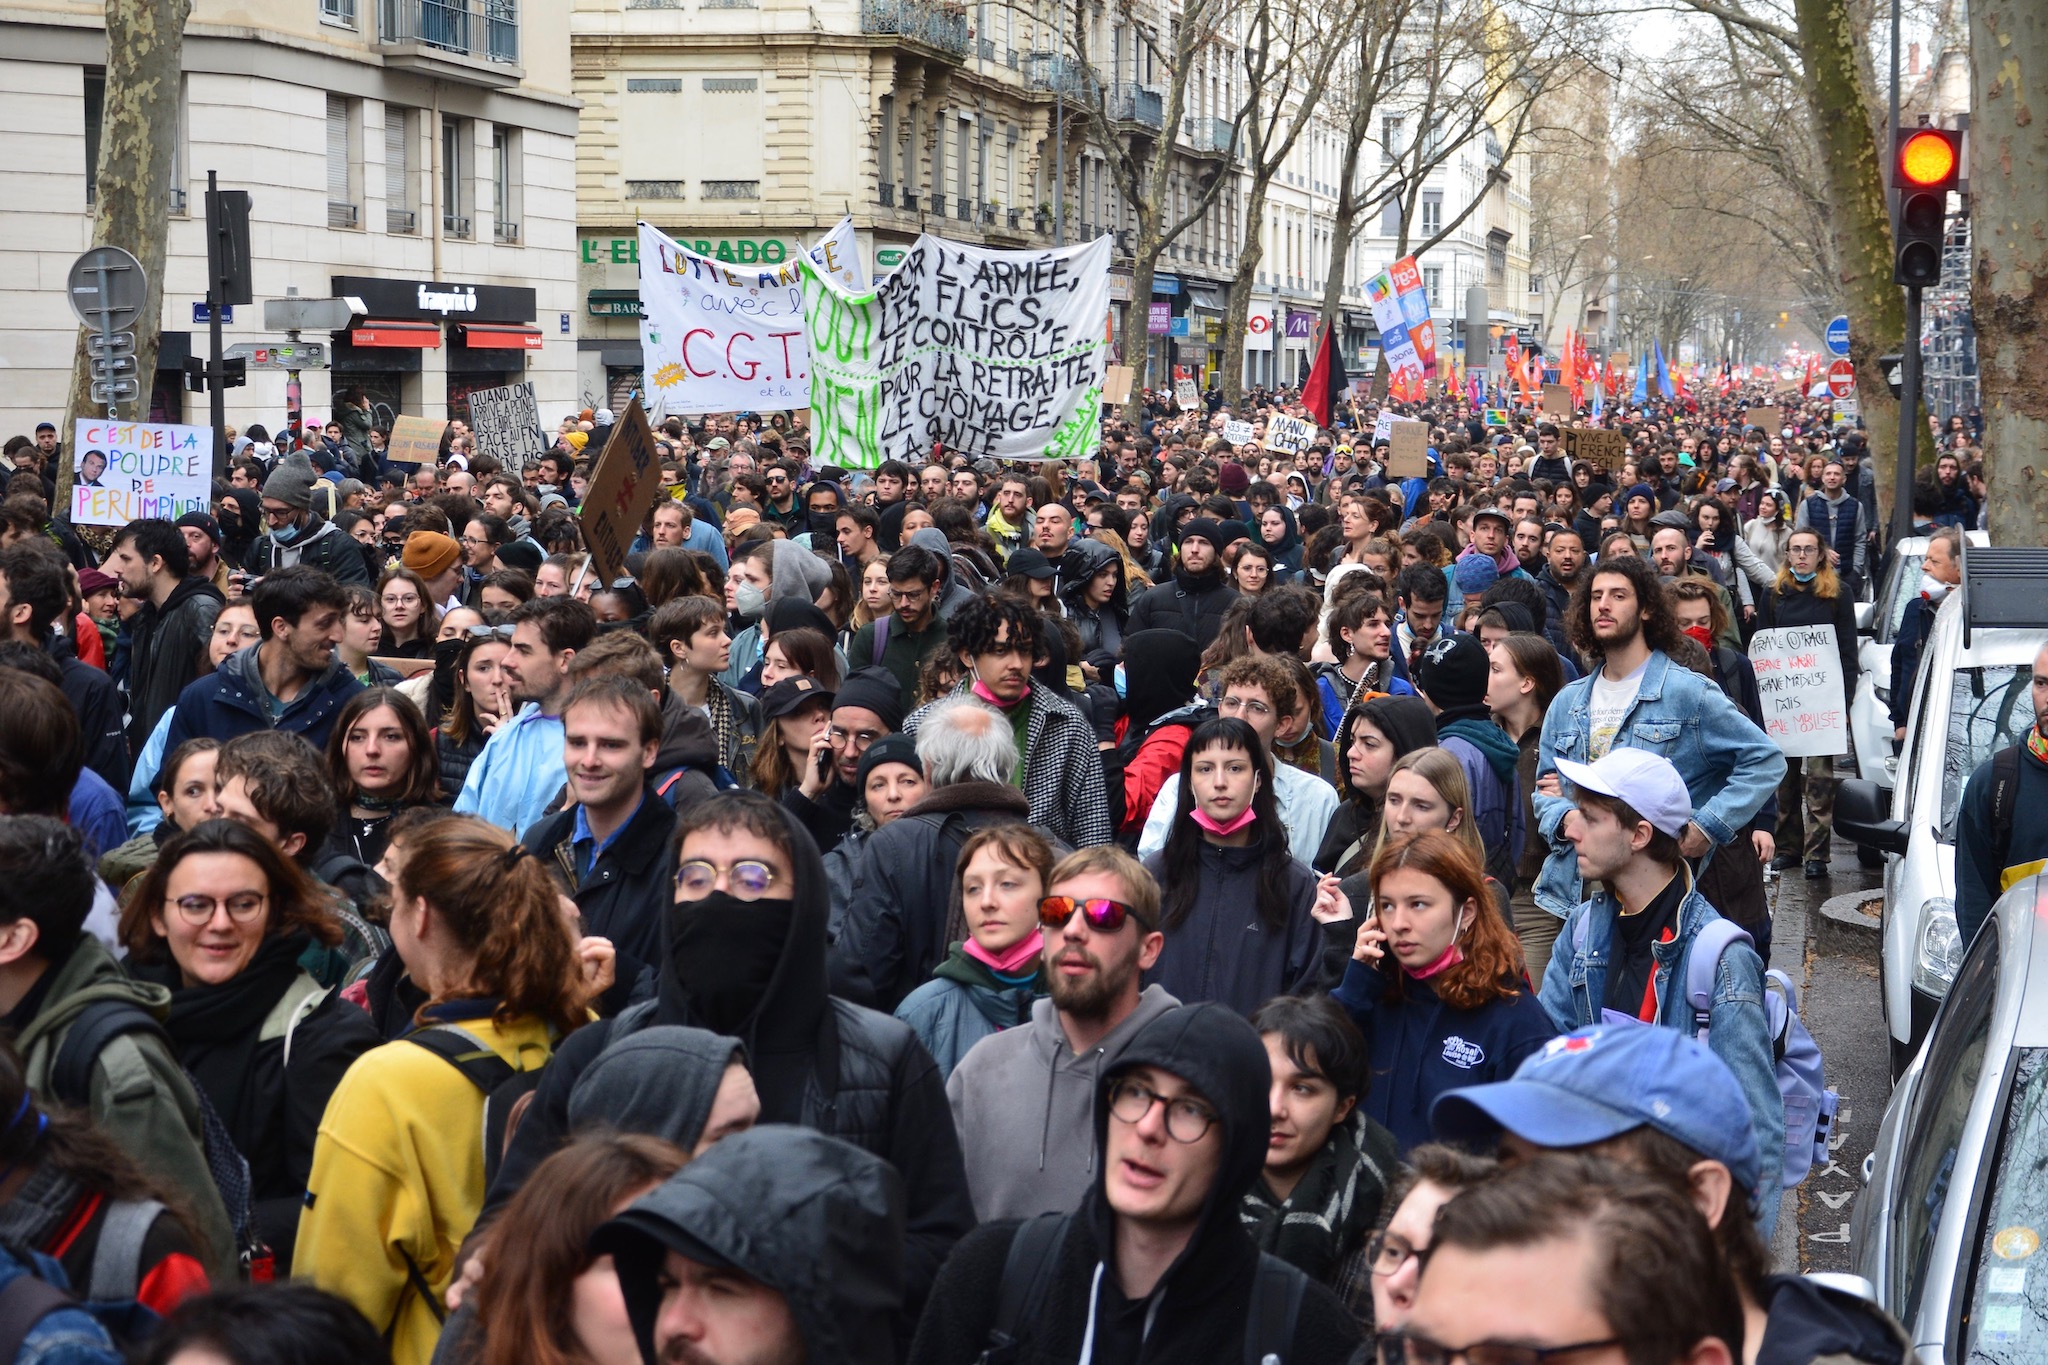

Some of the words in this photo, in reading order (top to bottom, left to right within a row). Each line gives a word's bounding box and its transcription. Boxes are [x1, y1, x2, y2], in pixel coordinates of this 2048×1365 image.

[659, 243, 743, 288] LUTTE
[701, 294, 779, 317] avec
[879, 285, 920, 341] LES
[1148, 307, 1160, 315] LON
[1148, 315, 1168, 323] IFFURE
[682, 328, 806, 381] C.G.T.
[879, 330, 907, 369] LE
[881, 361, 922, 407] POUR
[934, 351, 962, 387] LA
[470, 387, 510, 407] QUAND
[513, 382, 534, 399] ON
[759, 385, 774, 397] et
[779, 385, 792, 397] la
[474, 402, 502, 420] ARRIVE
[511, 396, 535, 415] PEINE
[881, 397, 914, 441] LE
[918, 383, 1062, 433] CHÔMAGE,
[482, 419, 494, 434] SE
[493, 414, 514, 433] FAIRE
[1271, 417, 1308, 436] MANU
[86, 424, 138, 445] C'EST
[141, 429, 163, 449] DE
[170, 430, 198, 451] LA
[478, 430, 509, 450] FACE
[509, 428, 520, 441] AU
[520, 424, 540, 443] FN
[502, 443, 518, 457] SE
[523, 440, 539, 454] LA
[1274, 432, 1309, 452] CHAO
[1608, 433, 1621, 444] LA
[1580, 443, 1625, 458] FRENCH
[109, 449, 200, 477] POUDRE
[132, 478, 155, 494] DE
